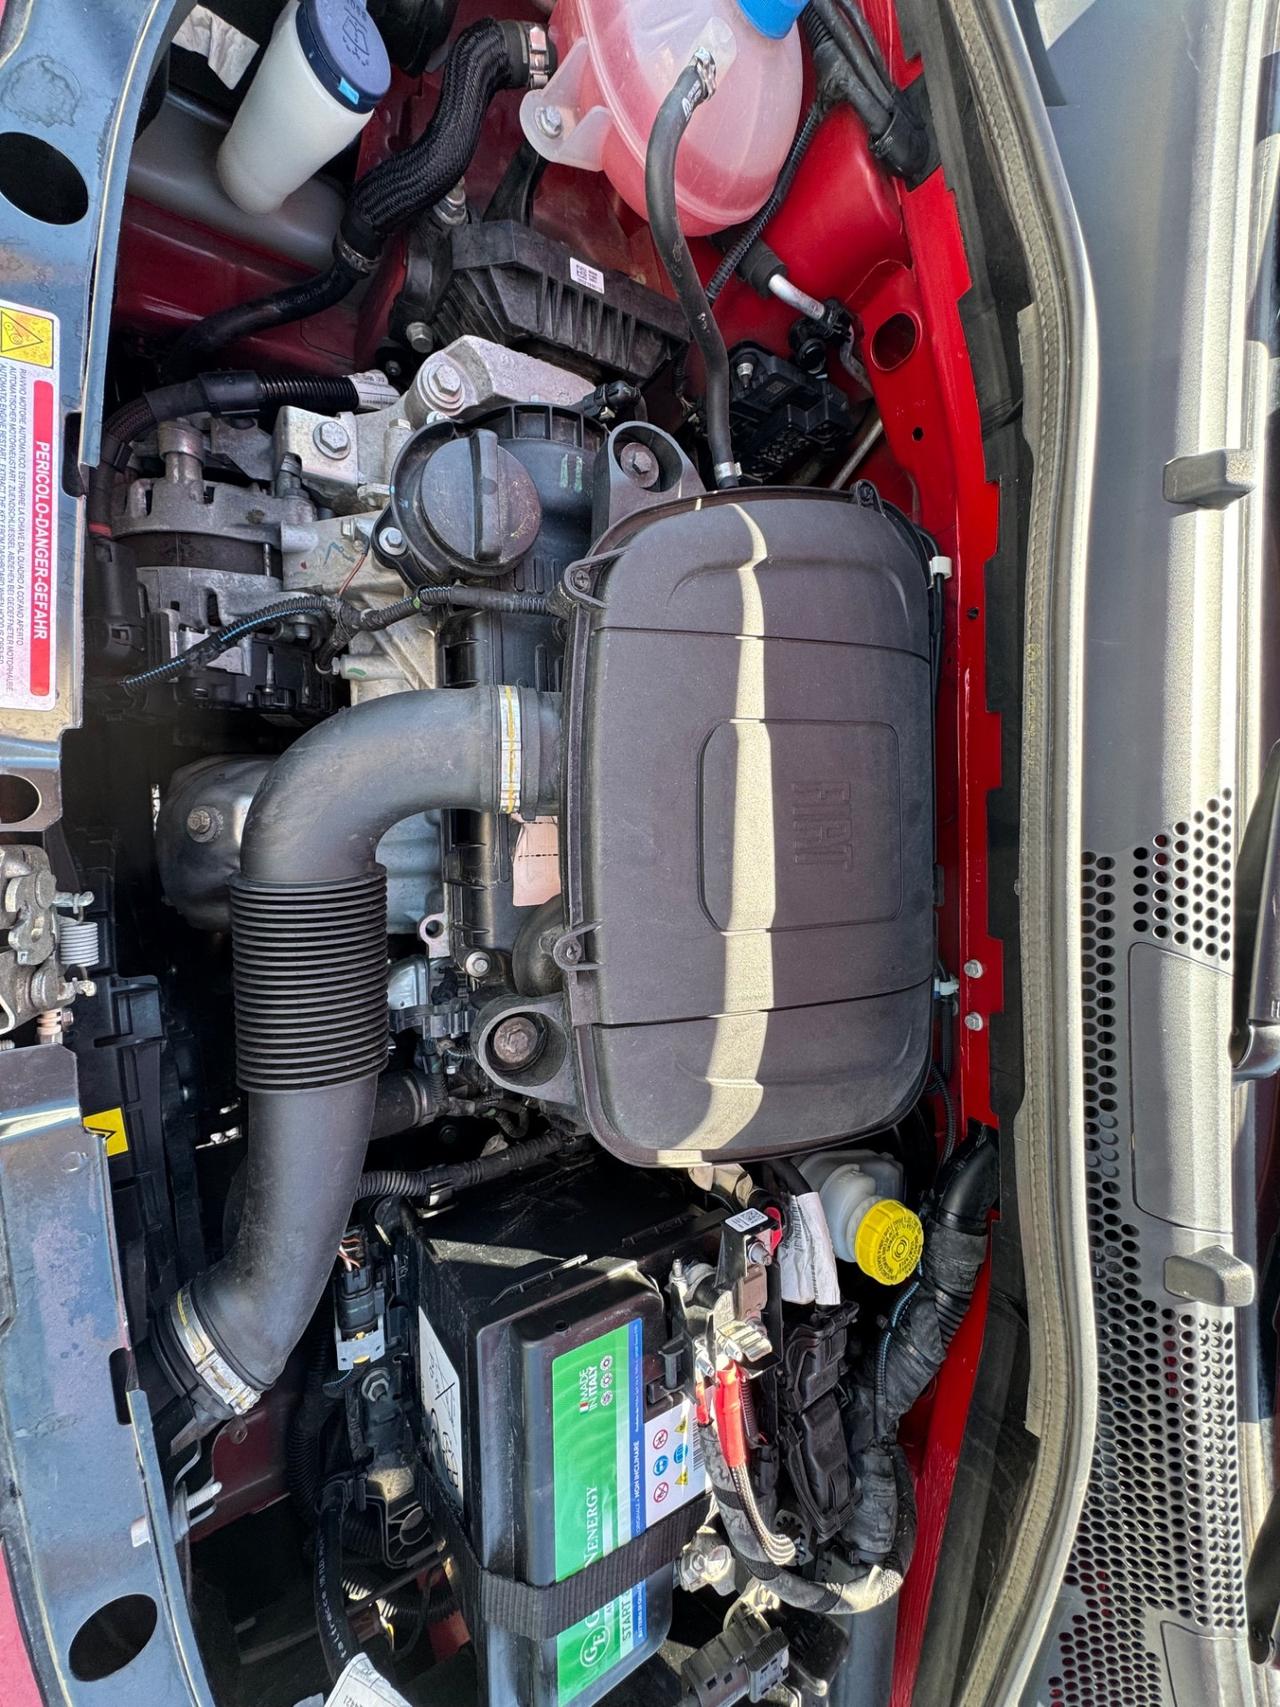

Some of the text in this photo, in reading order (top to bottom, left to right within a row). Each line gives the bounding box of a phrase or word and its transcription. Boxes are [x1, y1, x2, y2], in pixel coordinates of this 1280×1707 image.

[17, 517, 25, 540] CHIAVE
[17, 542, 25, 555] DAL
[33, 441, 50, 639] PERICOLO-DANGER-GEFAHR
[16, 620, 24, 646] APERTO
[791, 782, 854, 872] FIAT
[579, 1368, 589, 1402] MADE
[588, 1365, 598, 1411] IN ITALY
[632, 1440, 640, 1480] INCLINARE
[622, 1600, 632, 1641] START
